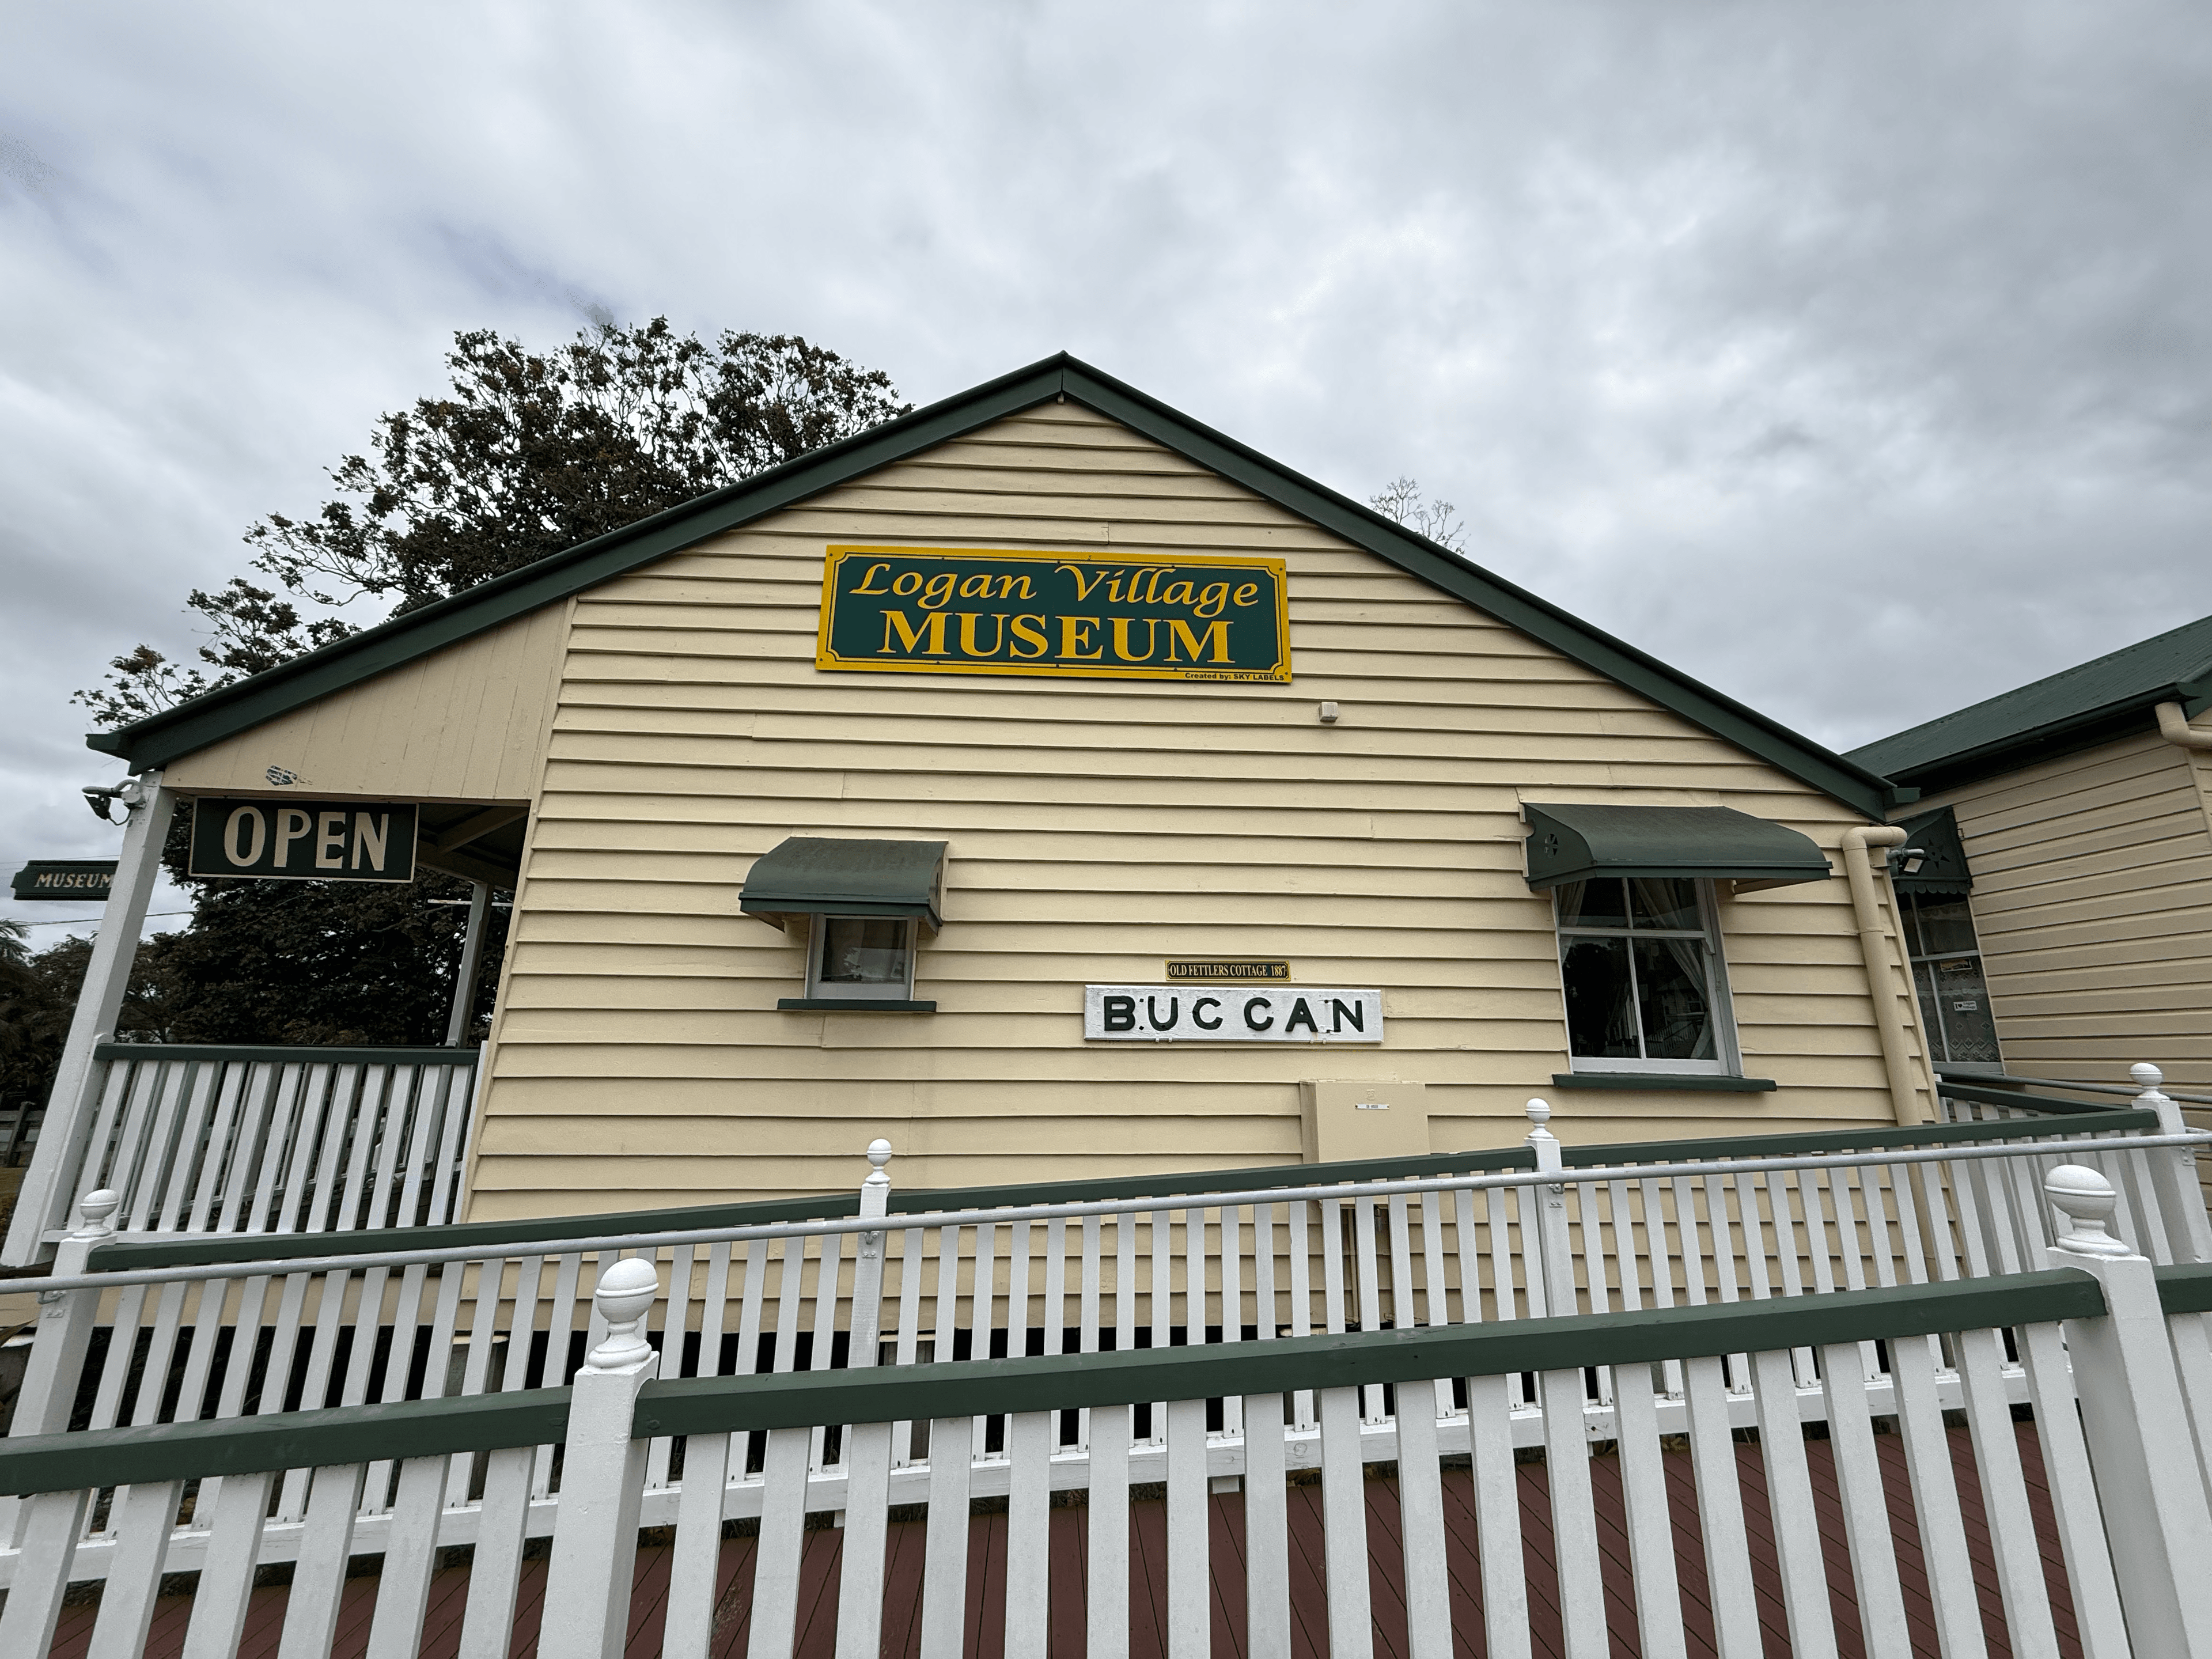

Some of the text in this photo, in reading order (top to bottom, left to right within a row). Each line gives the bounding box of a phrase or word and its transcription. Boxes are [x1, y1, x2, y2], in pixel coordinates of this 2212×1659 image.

[850, 563, 1258, 618] Logan Village
[877, 611, 1235, 663] MUSEUM
[224, 806, 389, 871] OPEN
[34, 873, 115, 888] MUSEUM
[1170, 964, 1286, 976] OLD FETTLERS COTTAGE 1887
[1104, 995, 1364, 1032] BUCCAN
